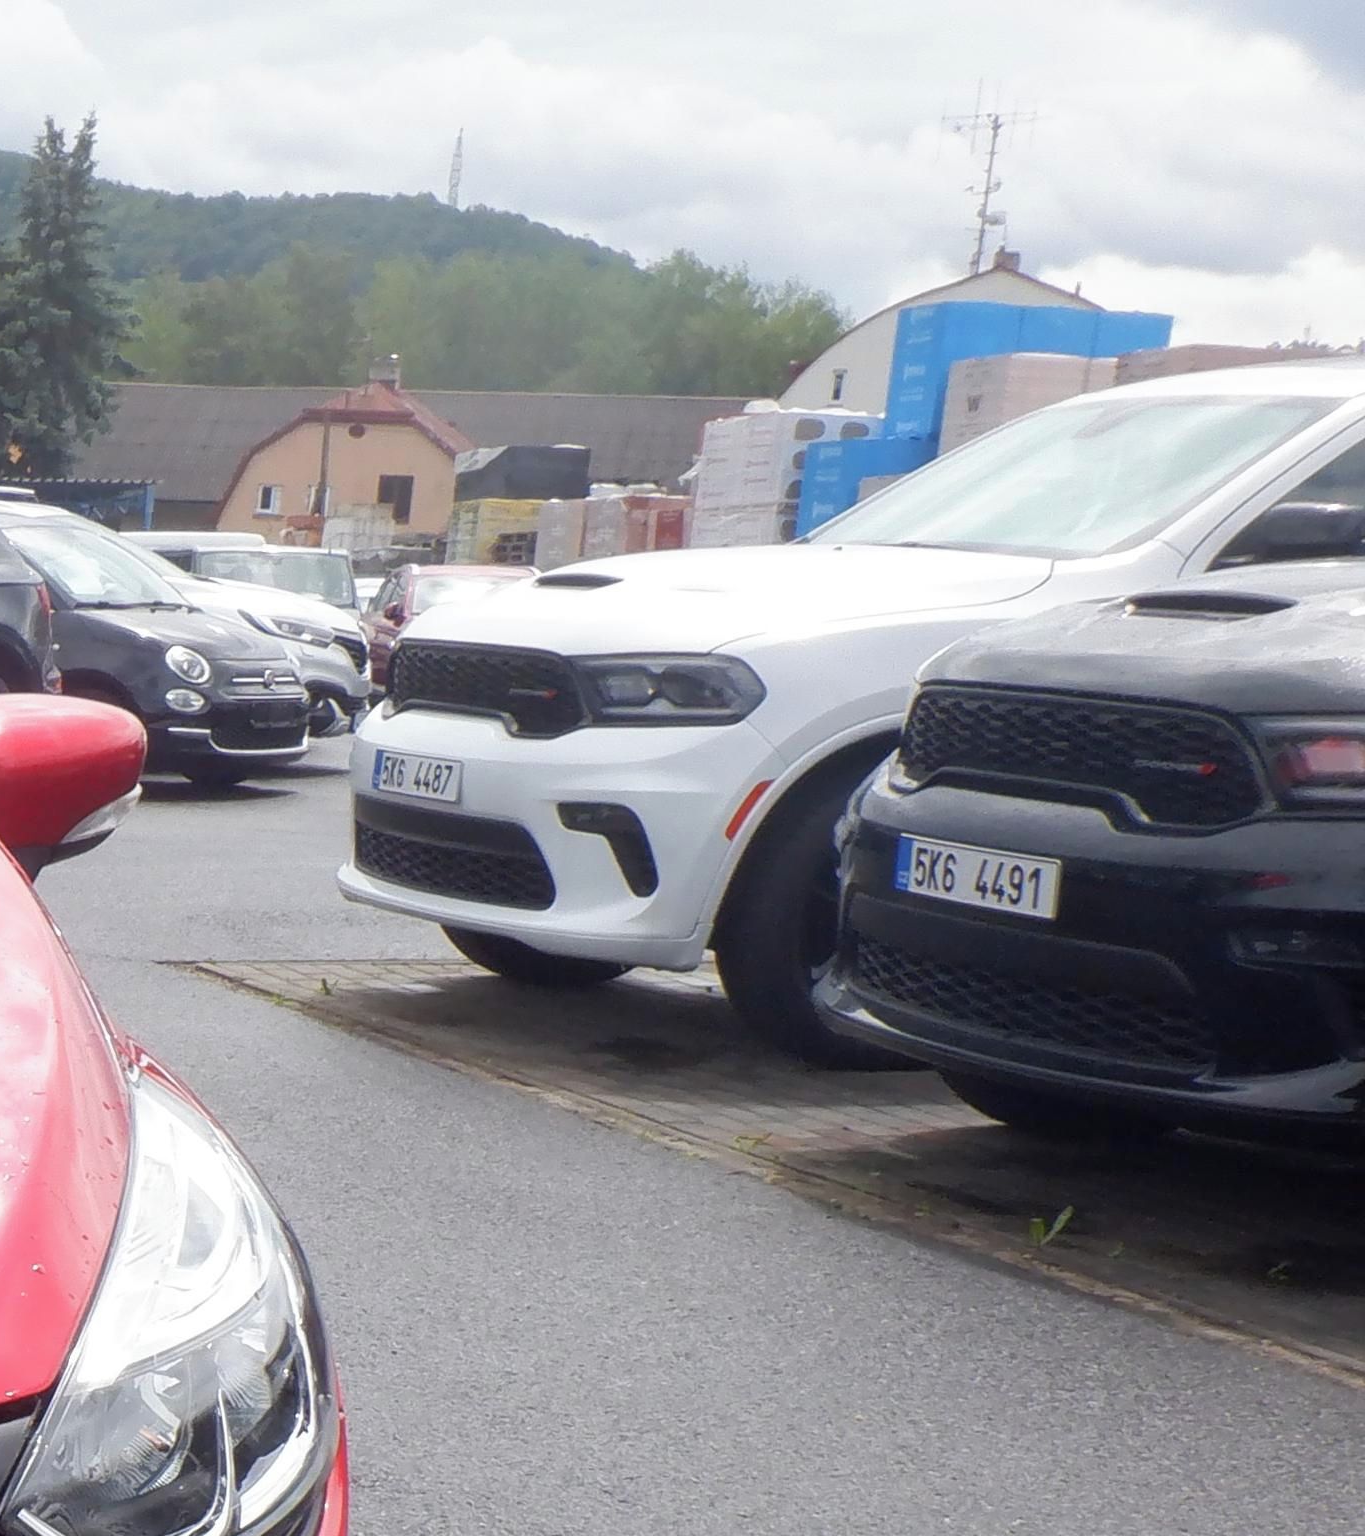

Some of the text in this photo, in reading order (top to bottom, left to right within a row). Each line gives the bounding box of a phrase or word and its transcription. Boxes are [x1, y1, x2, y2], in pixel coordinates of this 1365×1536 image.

[382, 756, 454, 795] 5K6 4487
[914, 847, 957, 893] 5K6
[975, 859, 1043, 910] 4491
